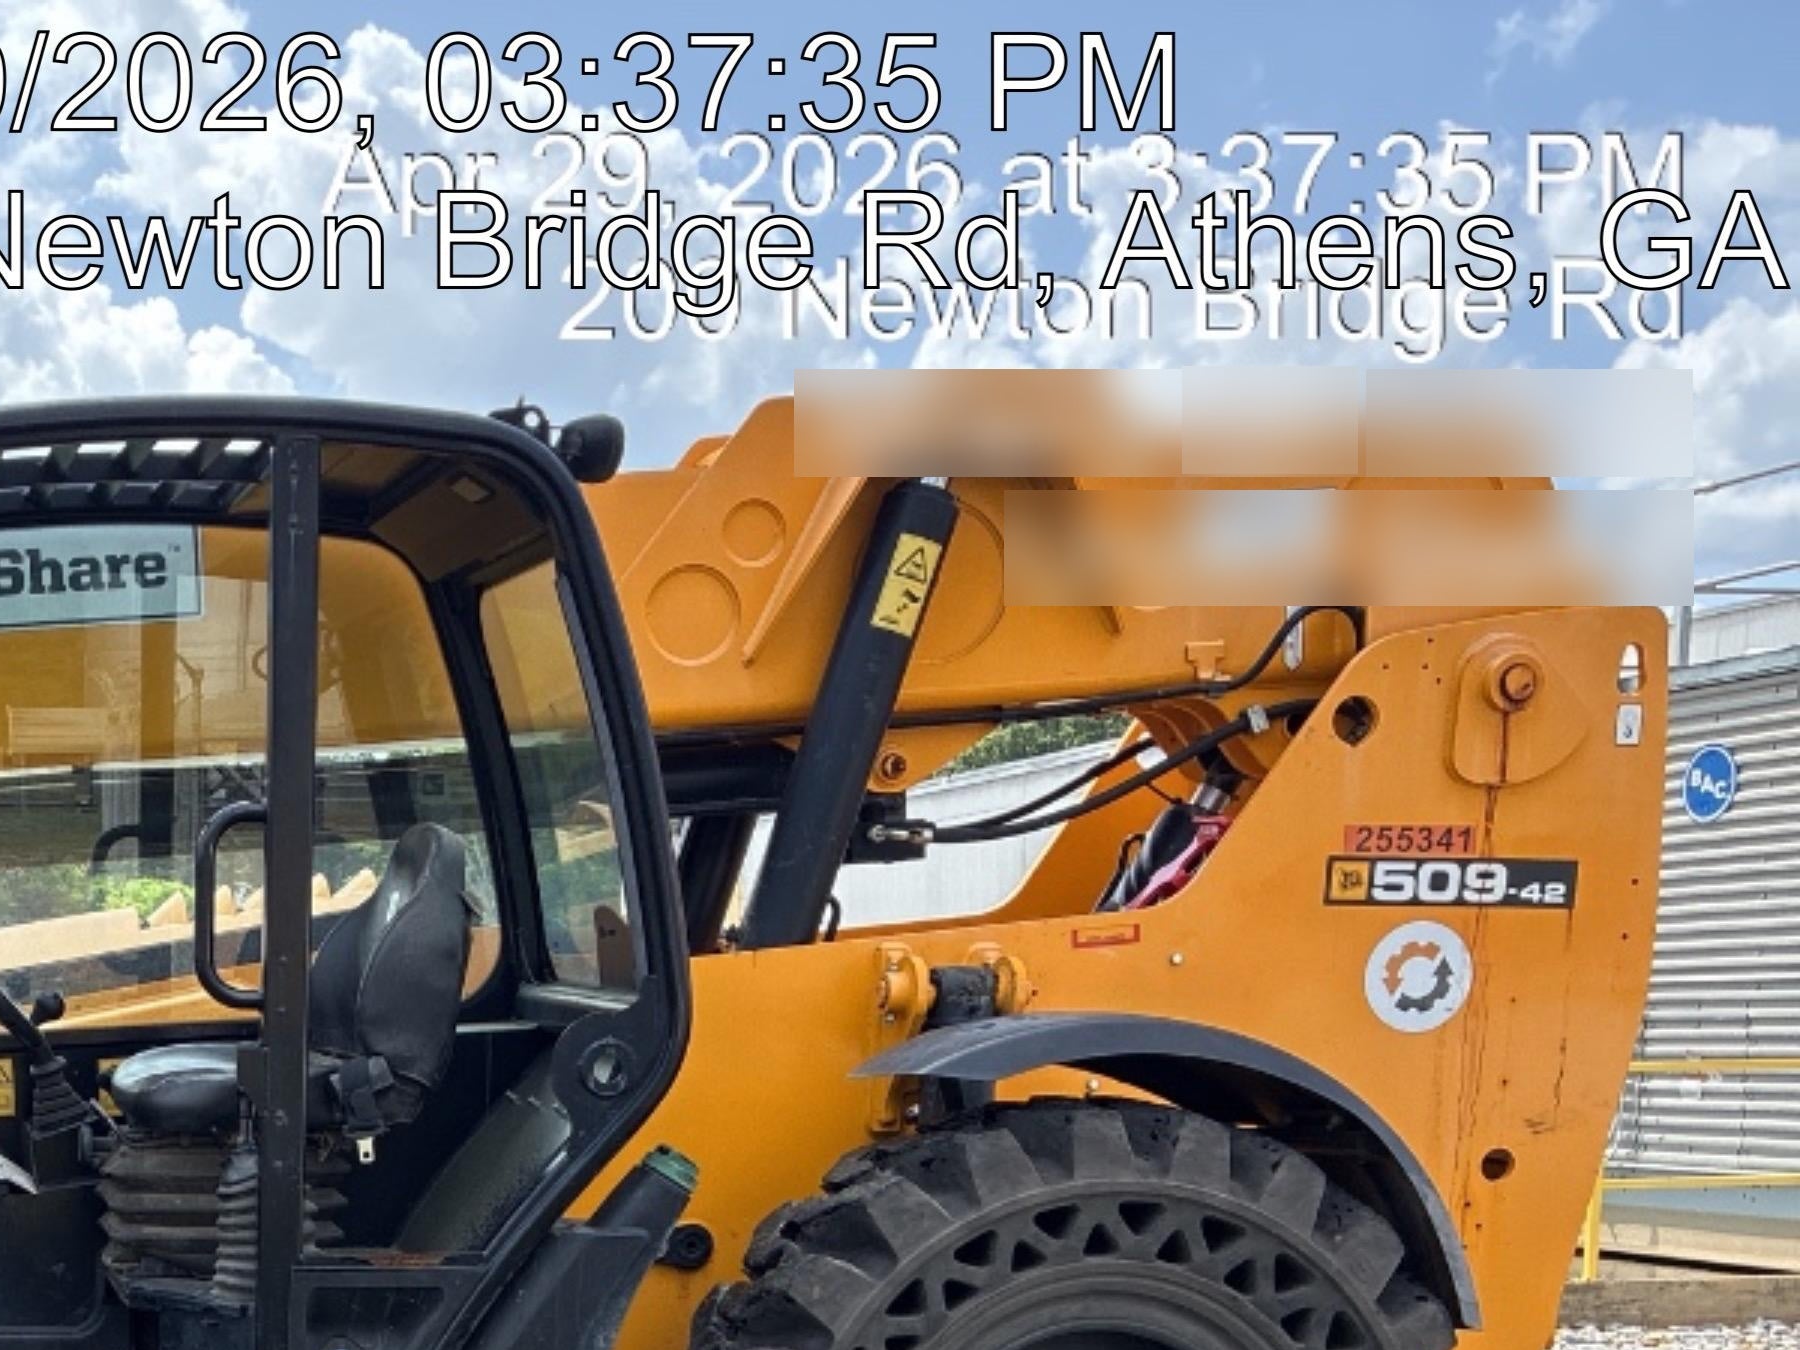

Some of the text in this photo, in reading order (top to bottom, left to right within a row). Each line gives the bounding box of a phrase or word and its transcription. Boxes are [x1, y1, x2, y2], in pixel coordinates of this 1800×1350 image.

[1691, 768, 1727, 799] BAC
[1356, 827, 1472, 852] 255341
[1371, 861, 1567, 903] 509-42
